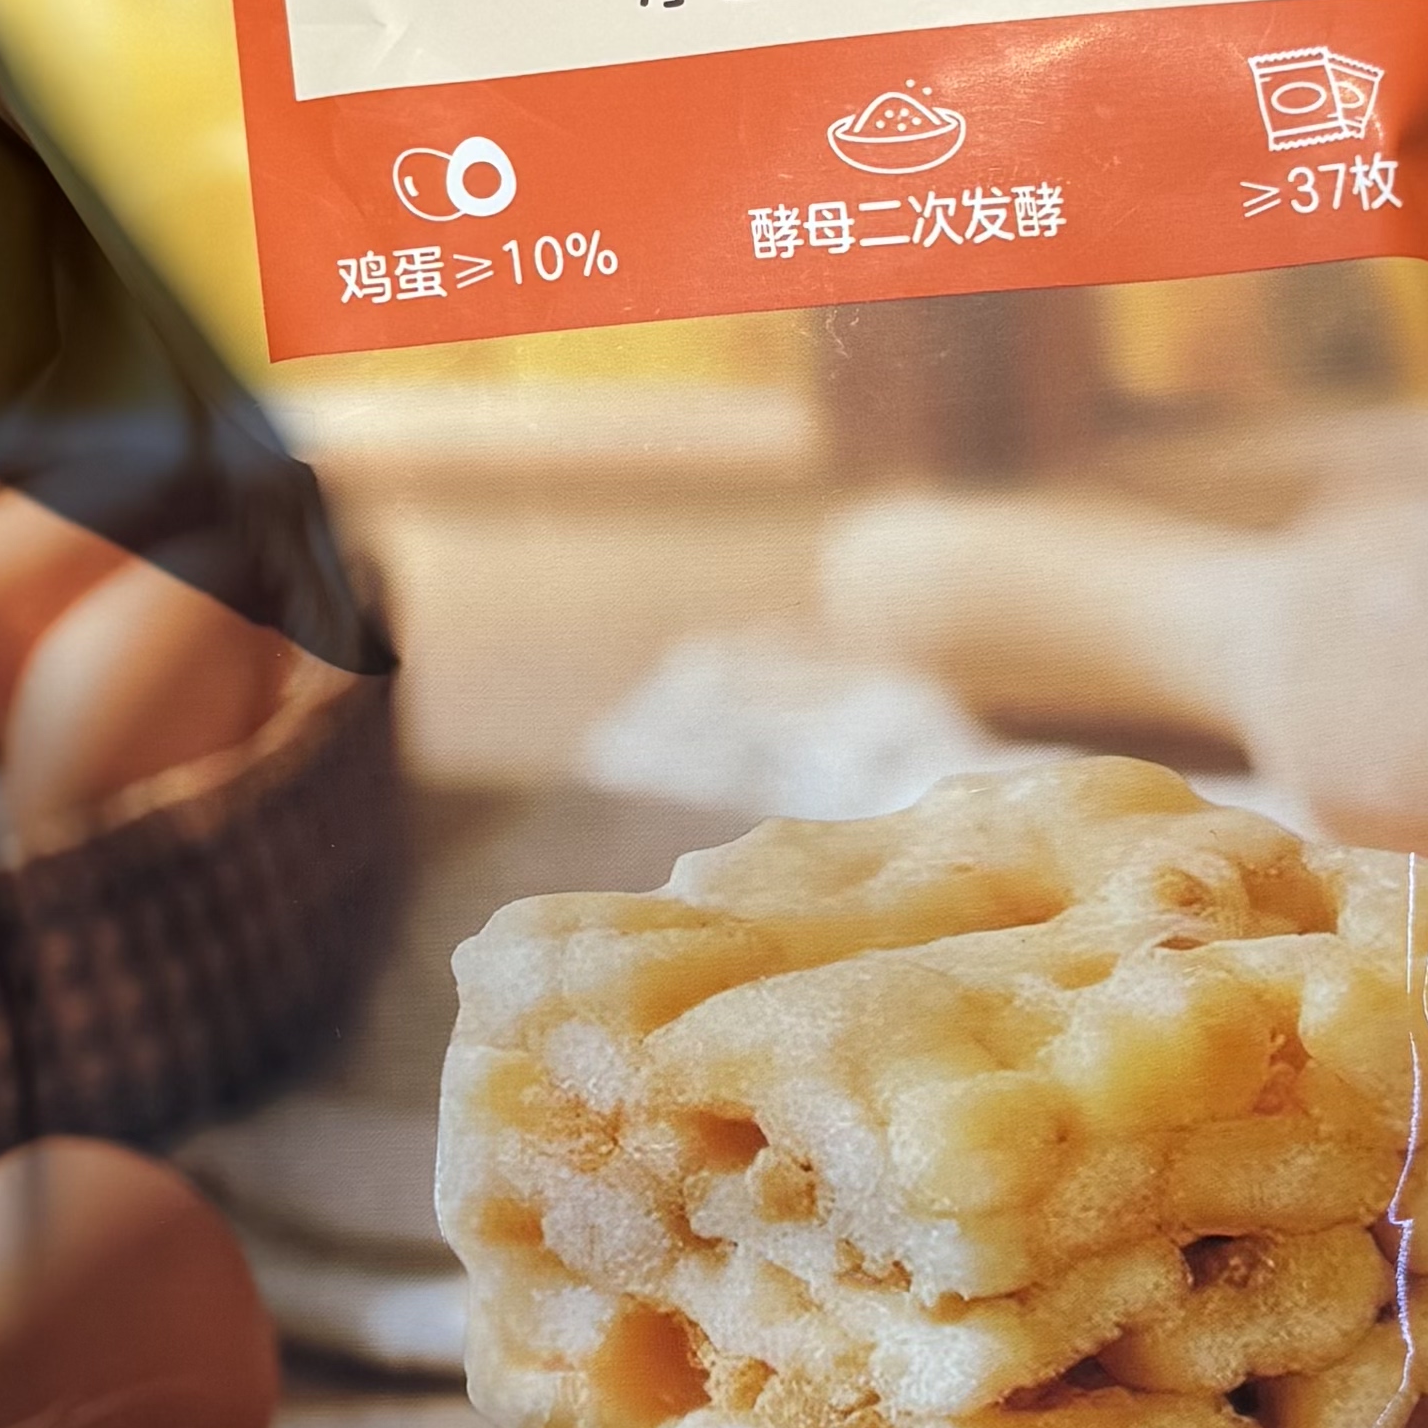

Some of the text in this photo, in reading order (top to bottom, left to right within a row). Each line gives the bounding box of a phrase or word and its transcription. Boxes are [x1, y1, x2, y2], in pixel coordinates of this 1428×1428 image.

[749, 182, 1068, 262] 酵母二次发酵
[1240, 151, 1404, 221] ≥37枚
[336, 230, 619, 305] 鸡蛋≥10%
